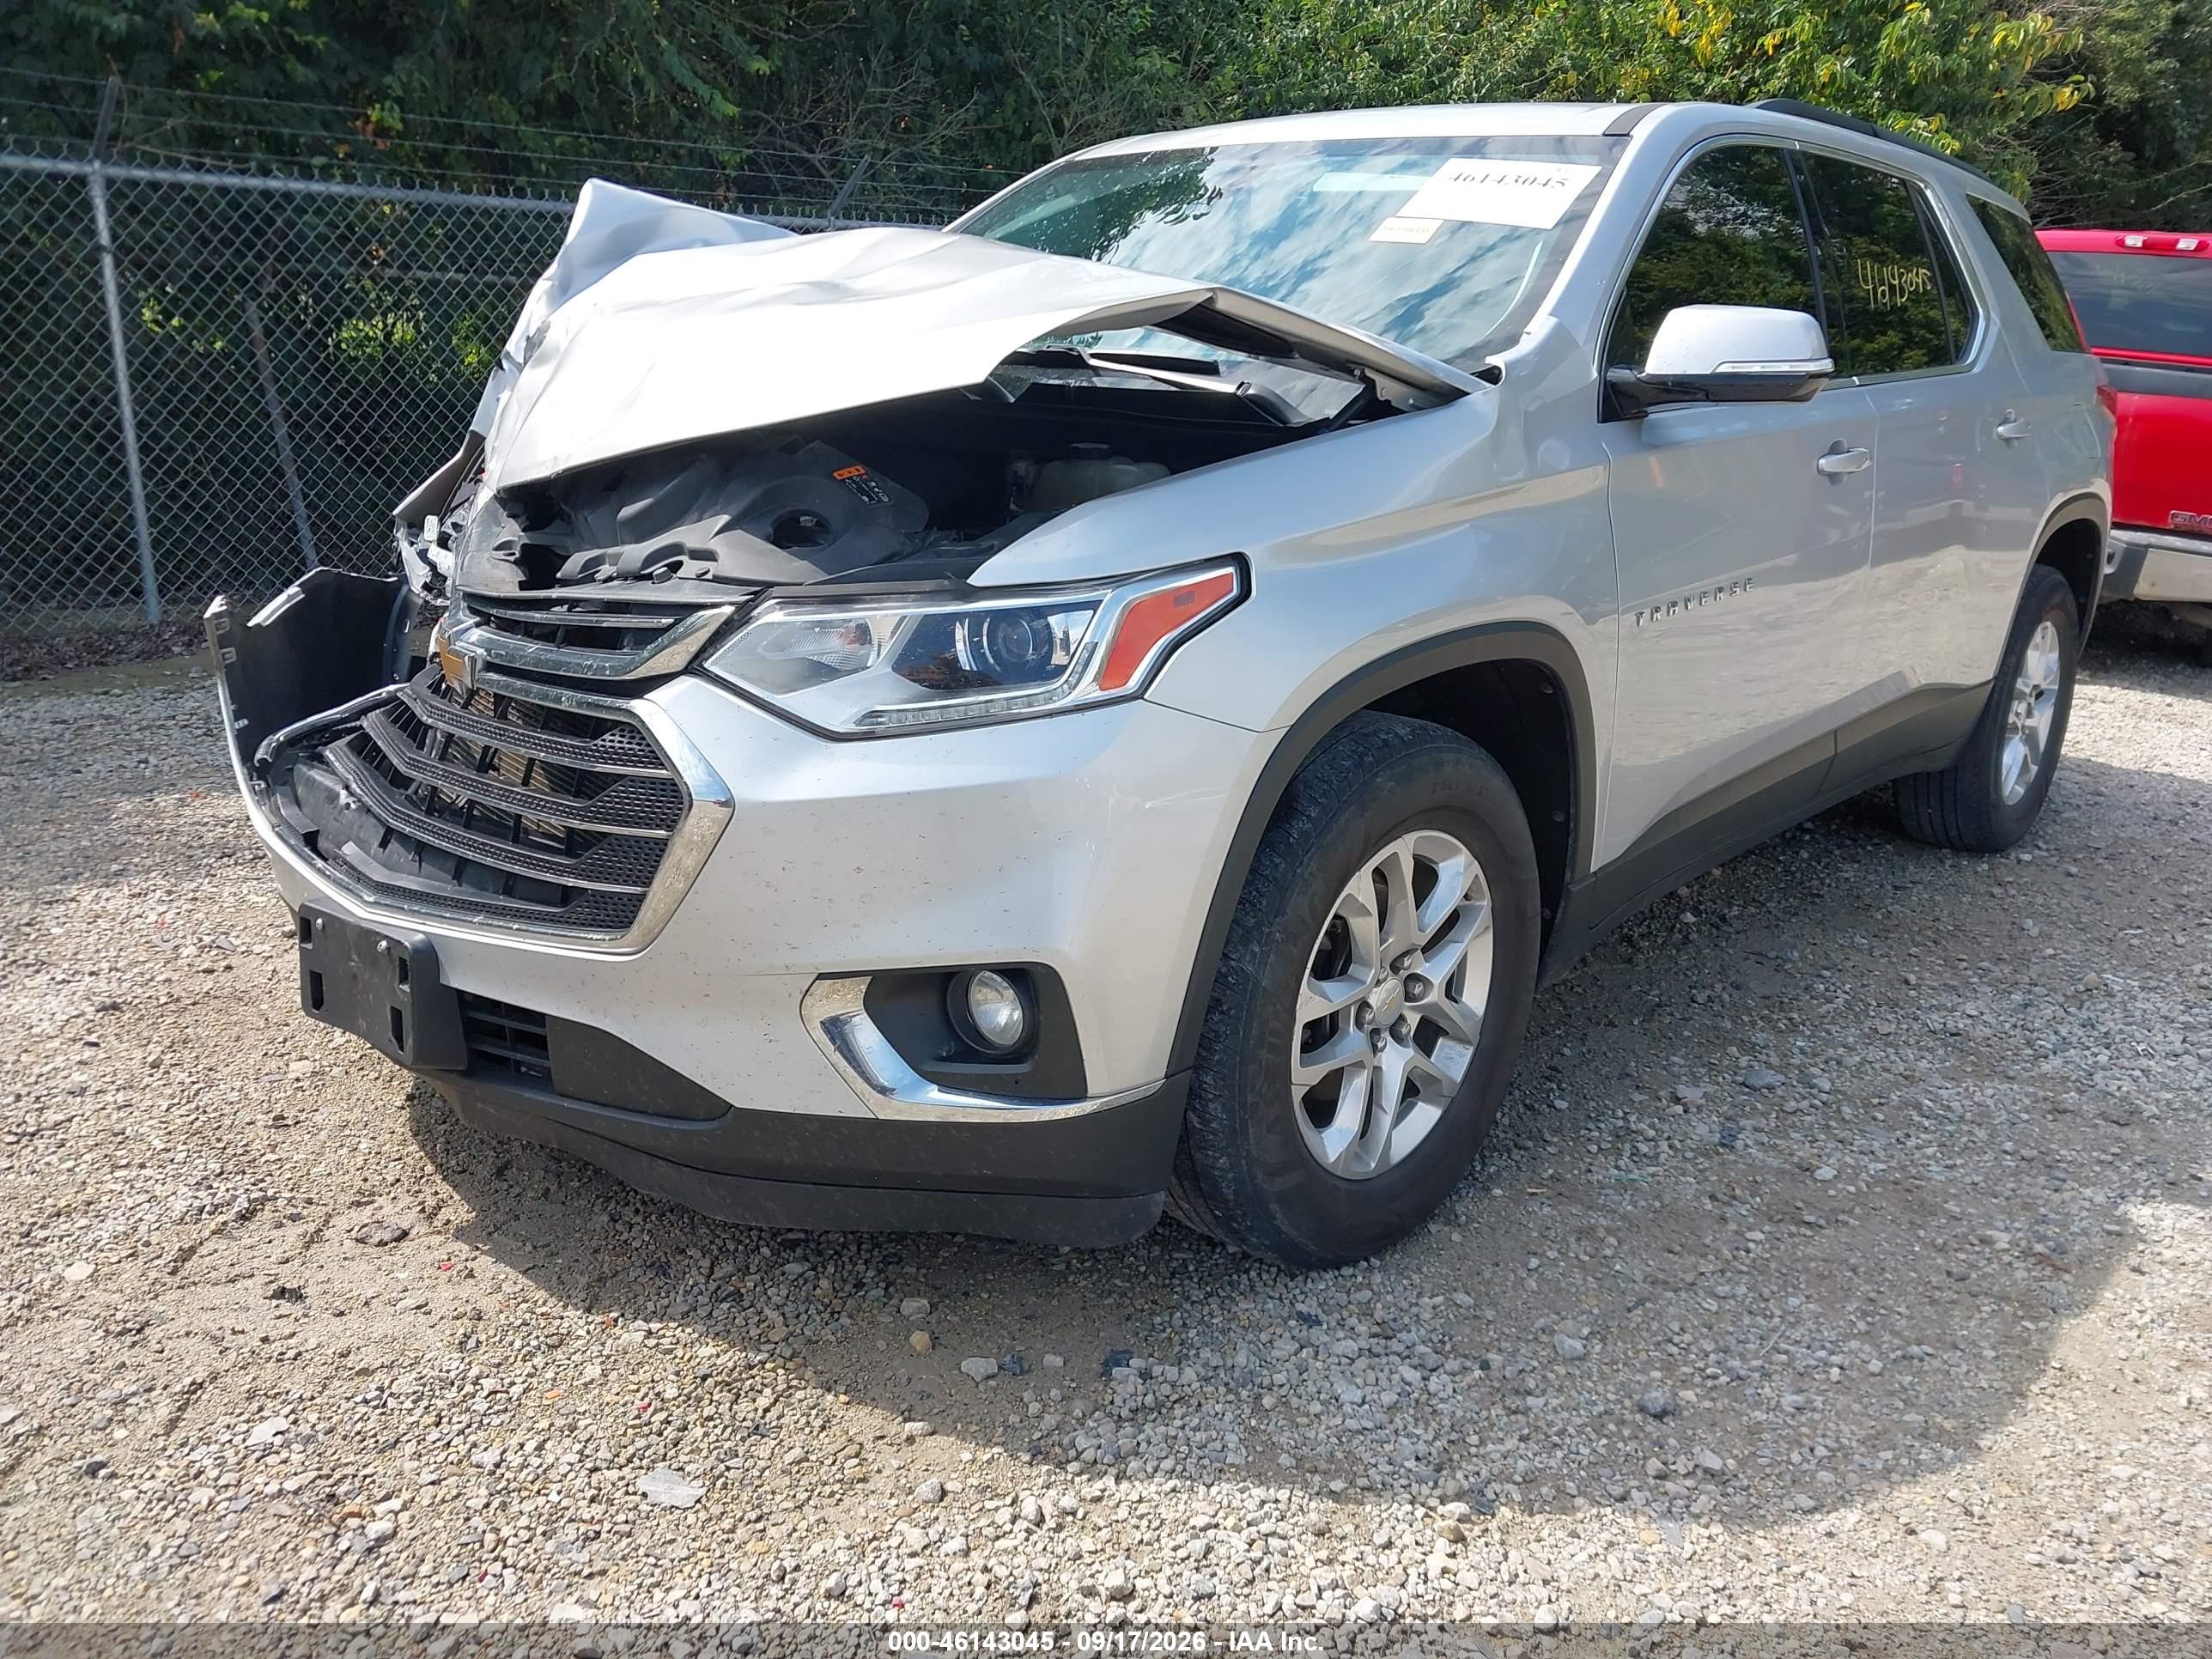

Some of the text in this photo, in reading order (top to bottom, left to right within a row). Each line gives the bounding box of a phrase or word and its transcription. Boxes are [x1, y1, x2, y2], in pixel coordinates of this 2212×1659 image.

[1448, 171, 1571, 190] 46143045
[1856, 258, 1931, 311] 46143045
[2168, 510, 2212, 529] GM
[1634, 577, 1755, 628] TRAVERSE
